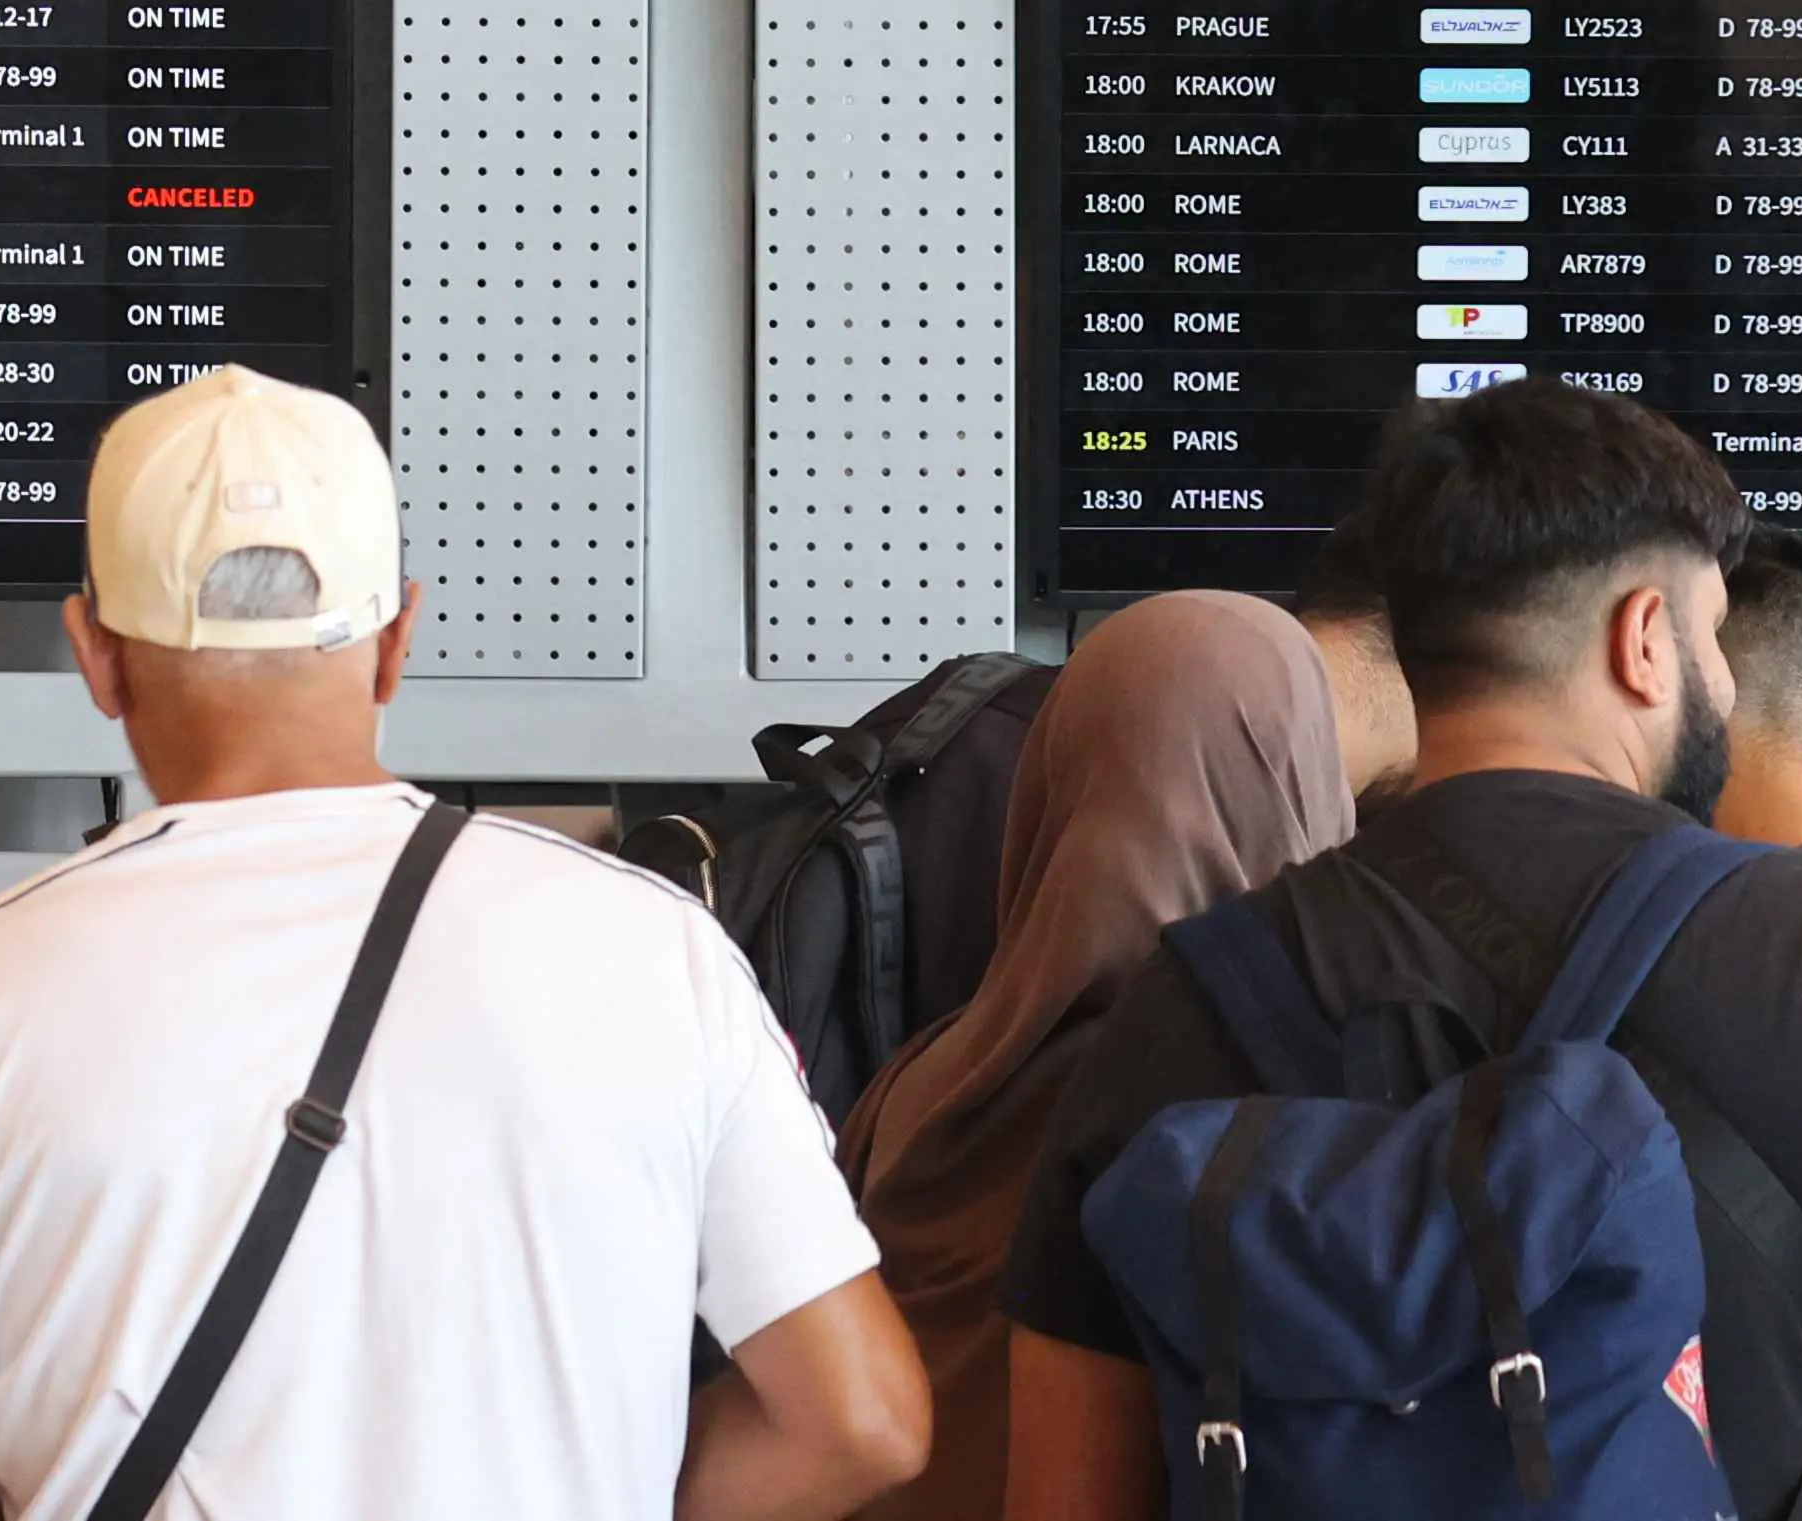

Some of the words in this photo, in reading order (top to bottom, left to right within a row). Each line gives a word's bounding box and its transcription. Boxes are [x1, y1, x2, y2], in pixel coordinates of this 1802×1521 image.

[72, 126, 85, 147] 1
[127, 126, 163, 148] ON
[168, 127, 226, 148] TIME
[1084, 134, 1145, 155] 18:00
[1175, 135, 1282, 156] LARNACA
[1562, 135, 1629, 156] CY111
[1715, 136, 1732, 156] A
[127, 187, 255, 208] CANCELED
[1082, 489, 1143, 510] 18:30
[1170, 489, 1264, 510] ATHENS
